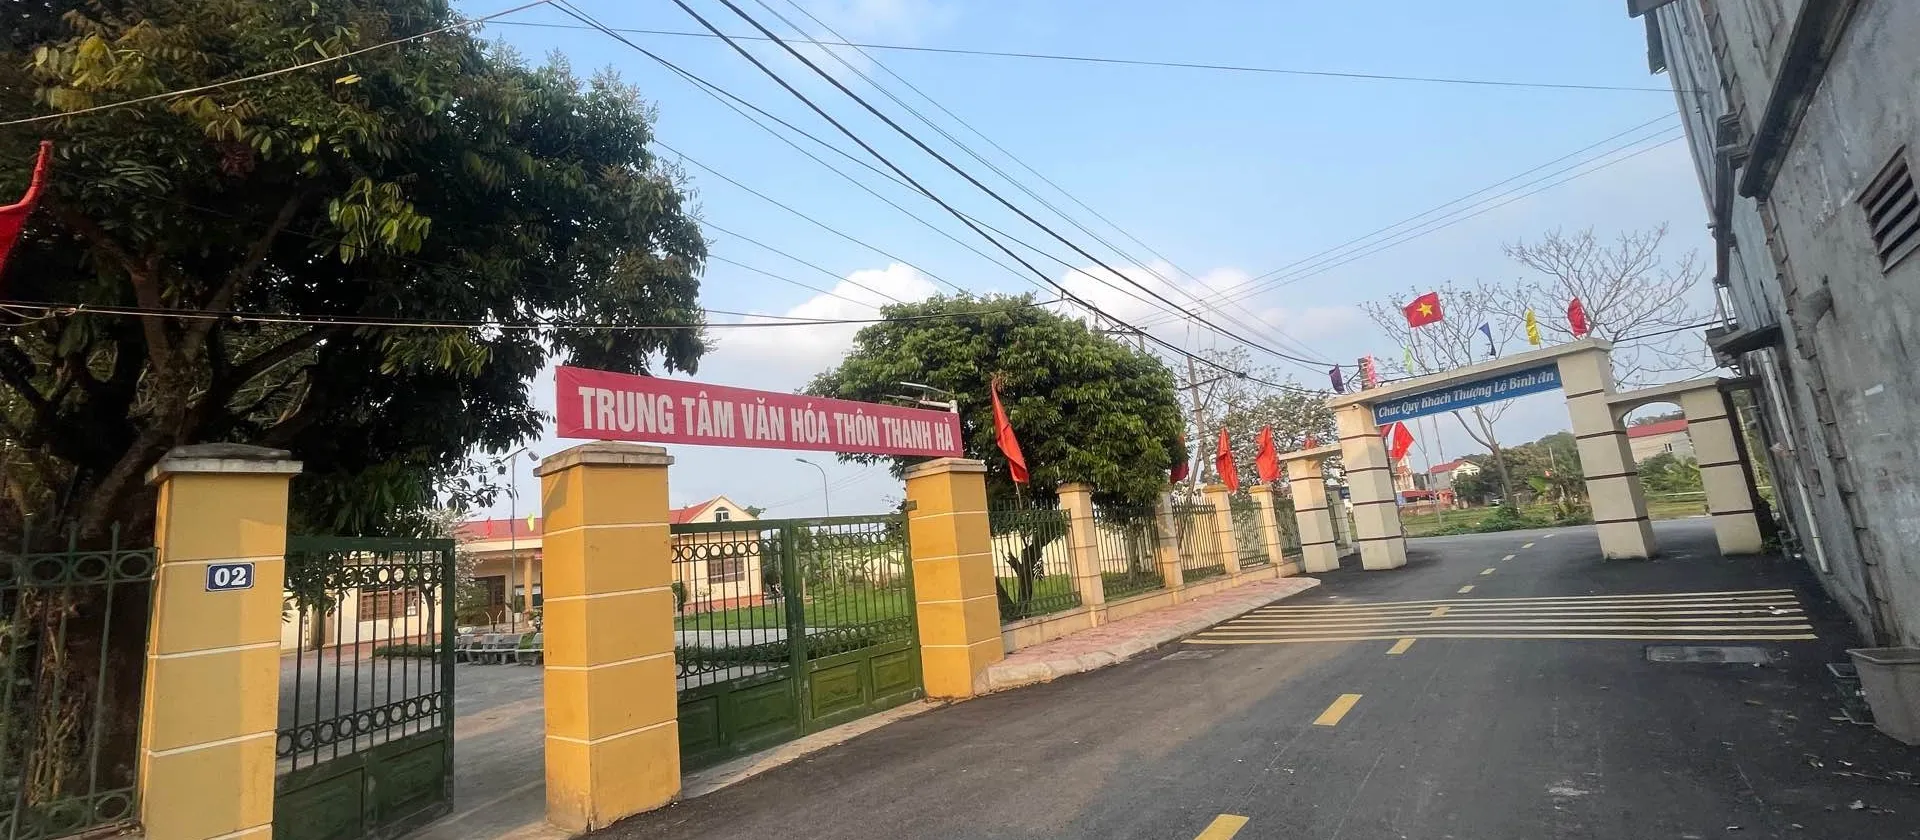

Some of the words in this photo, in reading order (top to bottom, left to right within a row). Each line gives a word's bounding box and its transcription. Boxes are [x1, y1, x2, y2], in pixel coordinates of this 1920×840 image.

[1378, 404, 1401, 417] Chúc
[1421, 392, 1452, 409] Khách
[1453, 385, 1492, 400] Thượng
[1494, 379, 1507, 395] Lộ
[1509, 374, 1536, 390] Bình
[578, 386, 675, 435] TRUNG
[681, 390, 736, 438] TÂM
[740, 396, 786, 442] VĂN
[790, 402, 831, 444] HÓA
[833, 408, 880, 447] THÔN
[882, 417, 932, 450] THANH
[934, 417, 955, 451] HÀ
[214, 566, 246, 587] 02
